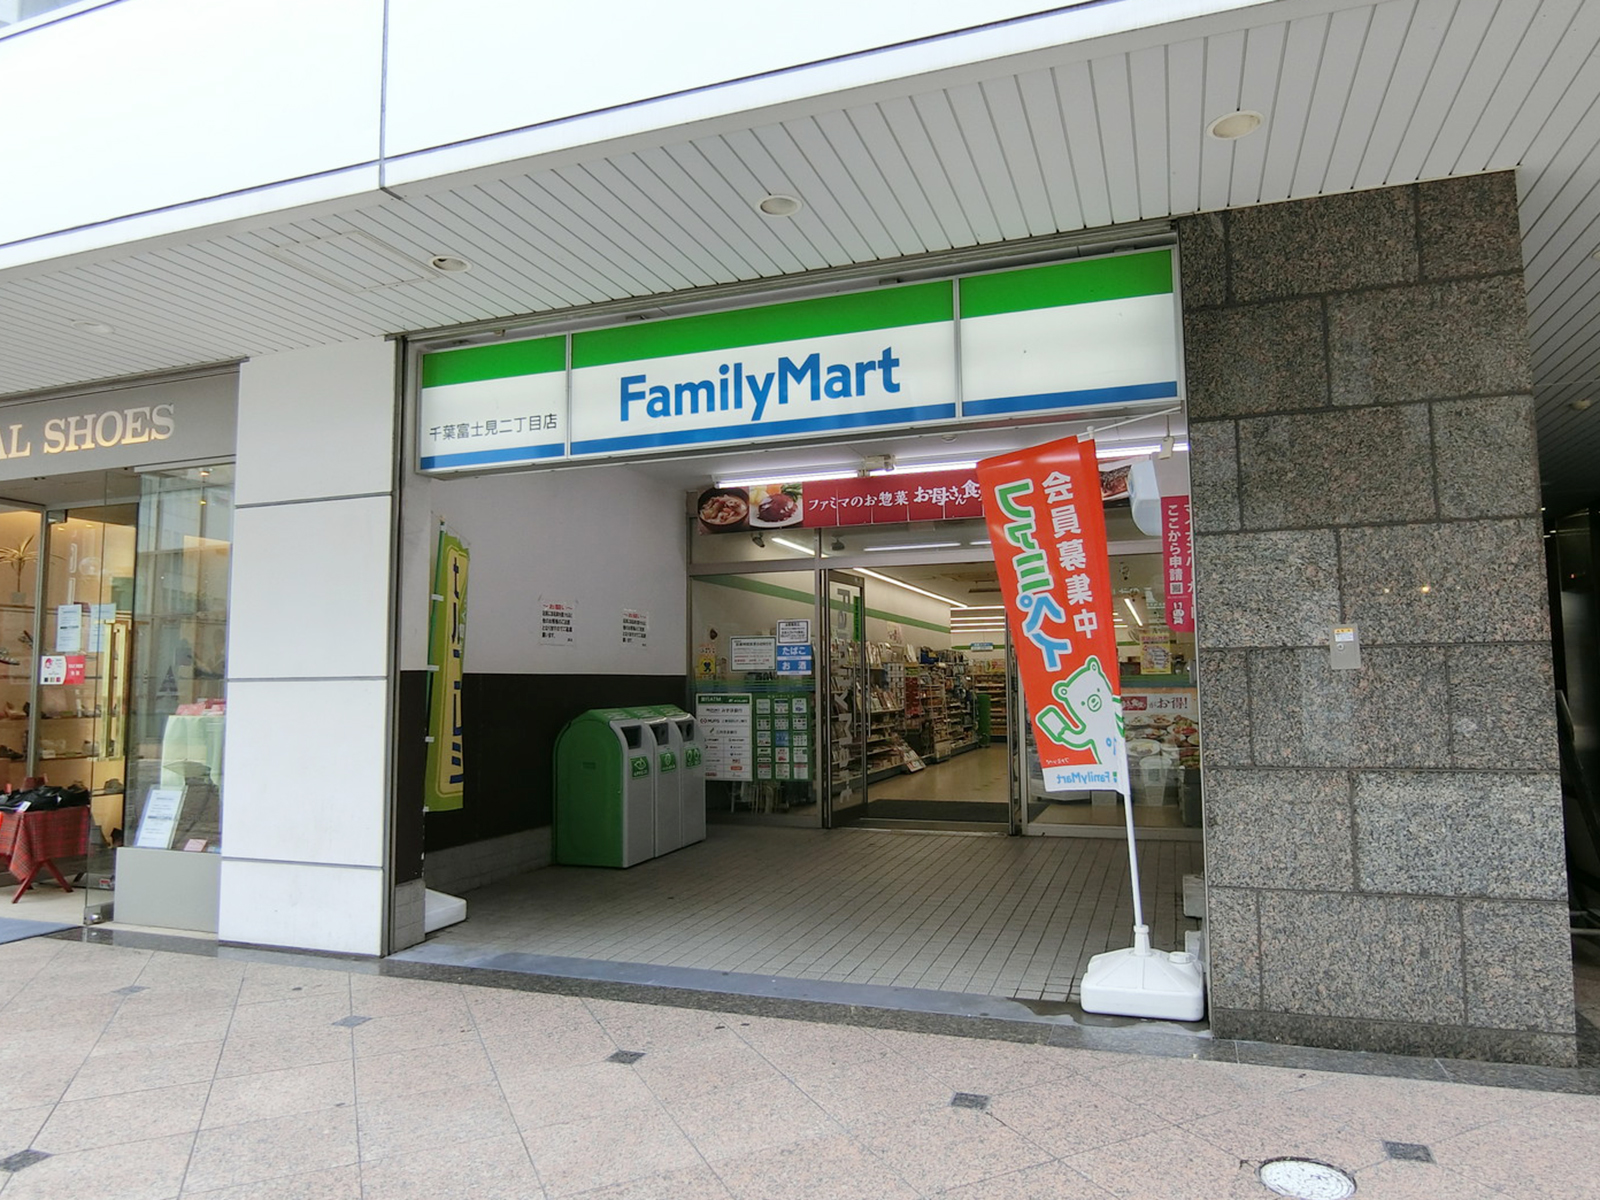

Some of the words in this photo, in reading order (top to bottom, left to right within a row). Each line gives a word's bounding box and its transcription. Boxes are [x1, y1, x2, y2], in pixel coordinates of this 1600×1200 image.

[620, 346, 901, 422] FamilyMart
[0, 424, 31, 460] L
[43, 403, 176, 454] SHOES
[429, 413, 558, 441] 千葉富士見二丁目店
[808, 490, 910, 512] ファミマのお惣菜
[913, 479, 982, 506] お母さん食
[782, 646, 807, 656] たばこ
